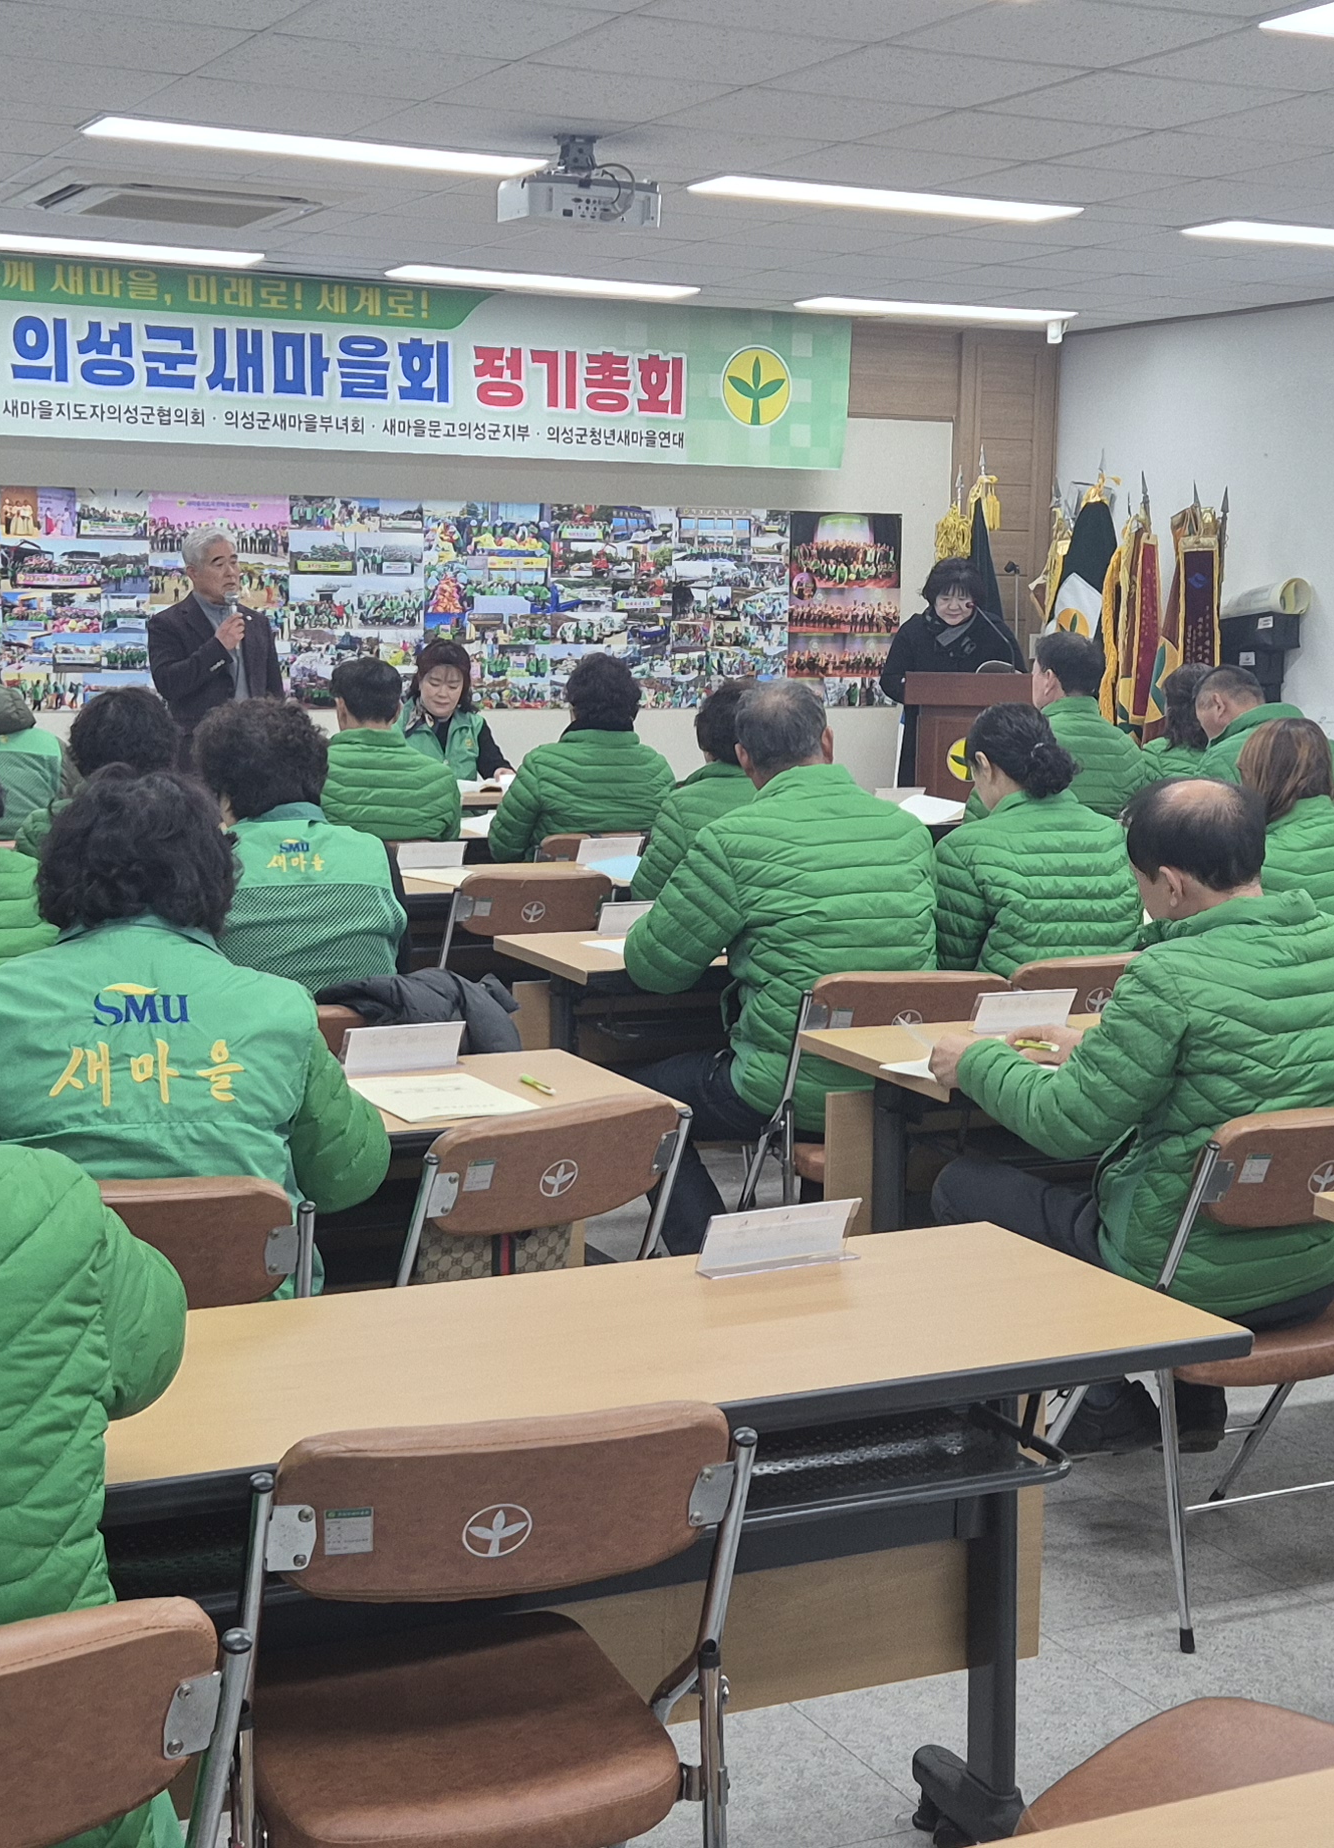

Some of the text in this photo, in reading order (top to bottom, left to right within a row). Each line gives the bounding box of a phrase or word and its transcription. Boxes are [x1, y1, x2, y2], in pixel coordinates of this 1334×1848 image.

[50, 263, 173, 306] 새마을,
[187, 274, 302, 312] 미래로!
[316, 284, 429, 319] 세계로!
[10, 315, 450, 403] 의성군새마을회
[473, 345, 683, 415] 정기총회
[2, 398, 206, 428] 새마을지도자의성군협의회
[224, 410, 365, 435] 의성군새마을부녀회
[382, 418, 530, 442] 새마을문고의성군지부
[546, 425, 685, 449] 의성군청년새마을연대
[266, 853, 325, 872] 새마을
[279, 842, 310, 853] SMU
[93, 989, 190, 1025] SMU
[48, 1038, 245, 1107] 새마을
